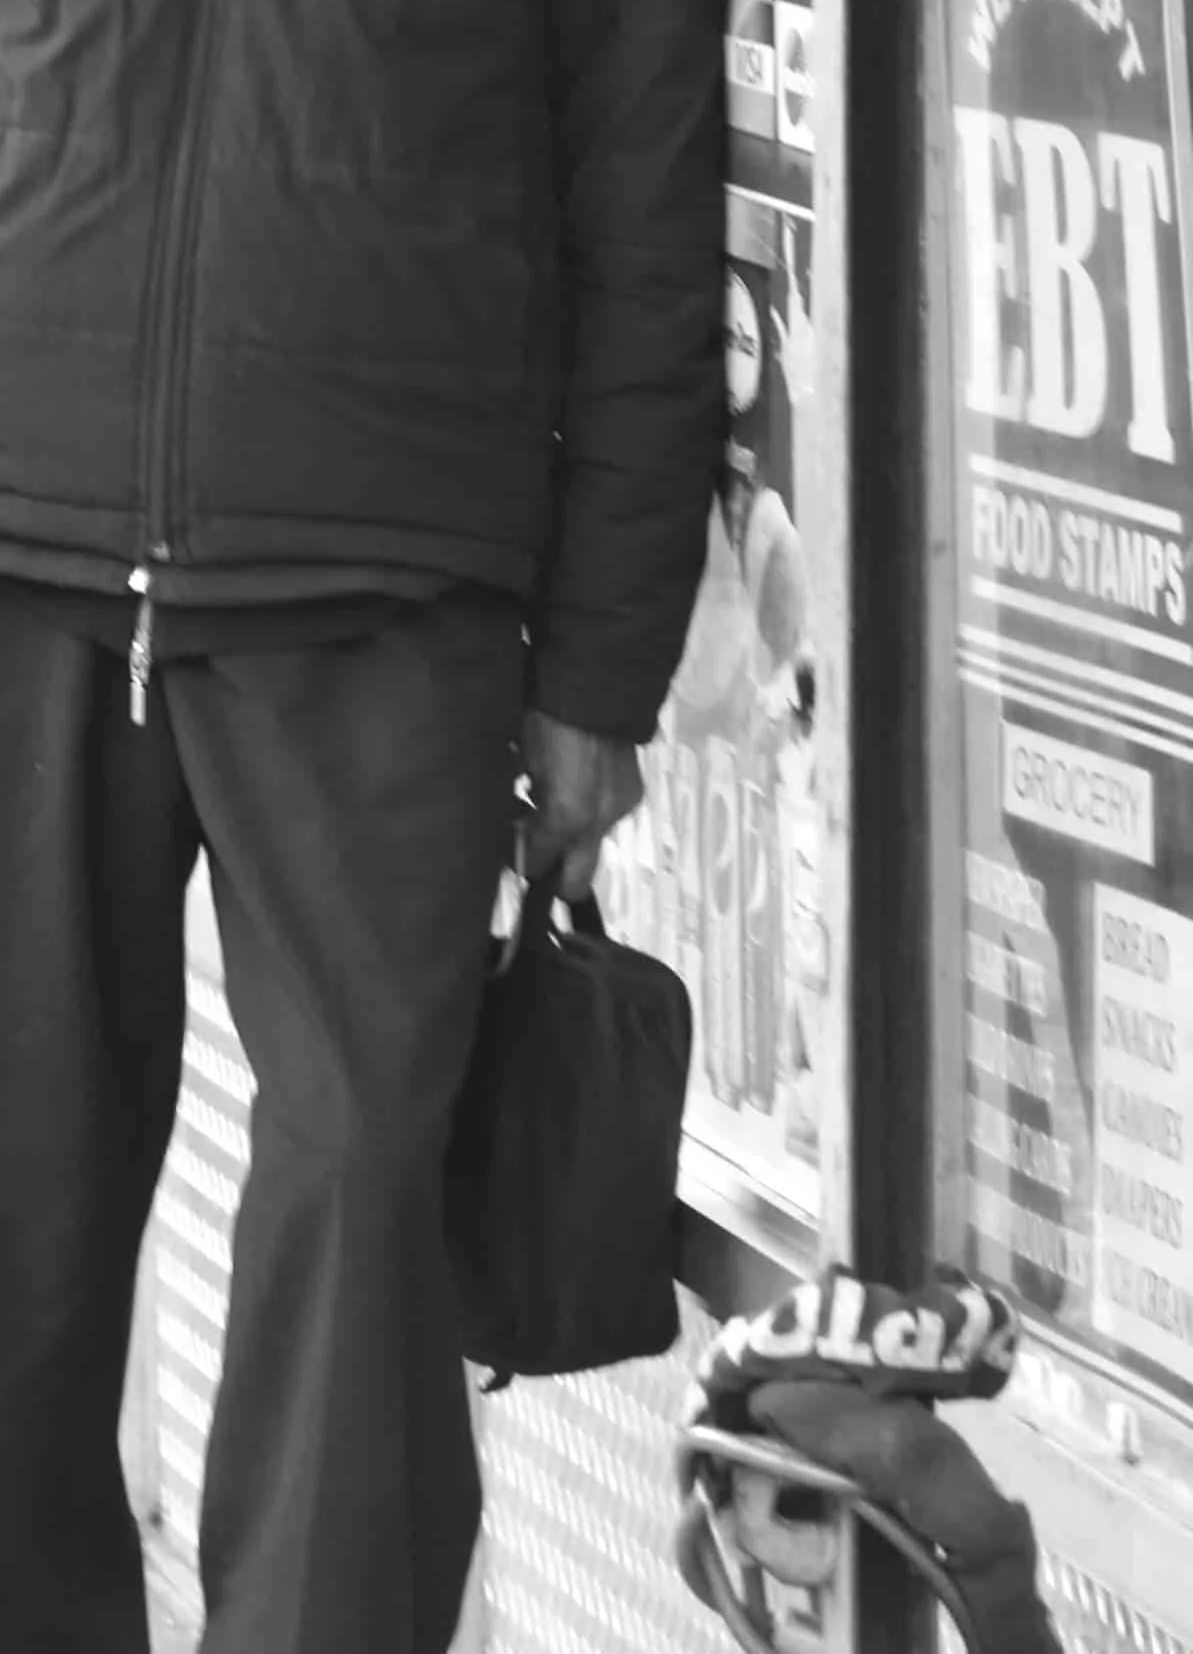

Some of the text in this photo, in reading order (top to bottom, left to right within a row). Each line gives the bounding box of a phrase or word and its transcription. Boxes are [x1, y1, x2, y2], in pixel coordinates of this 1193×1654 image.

[953, 104, 1177, 466] EBT
[972, 485, 1186, 628] FOOD STAMPS
[1012, 744, 1142, 844] GROCERY
[1102, 910, 1170, 984] BREAD
